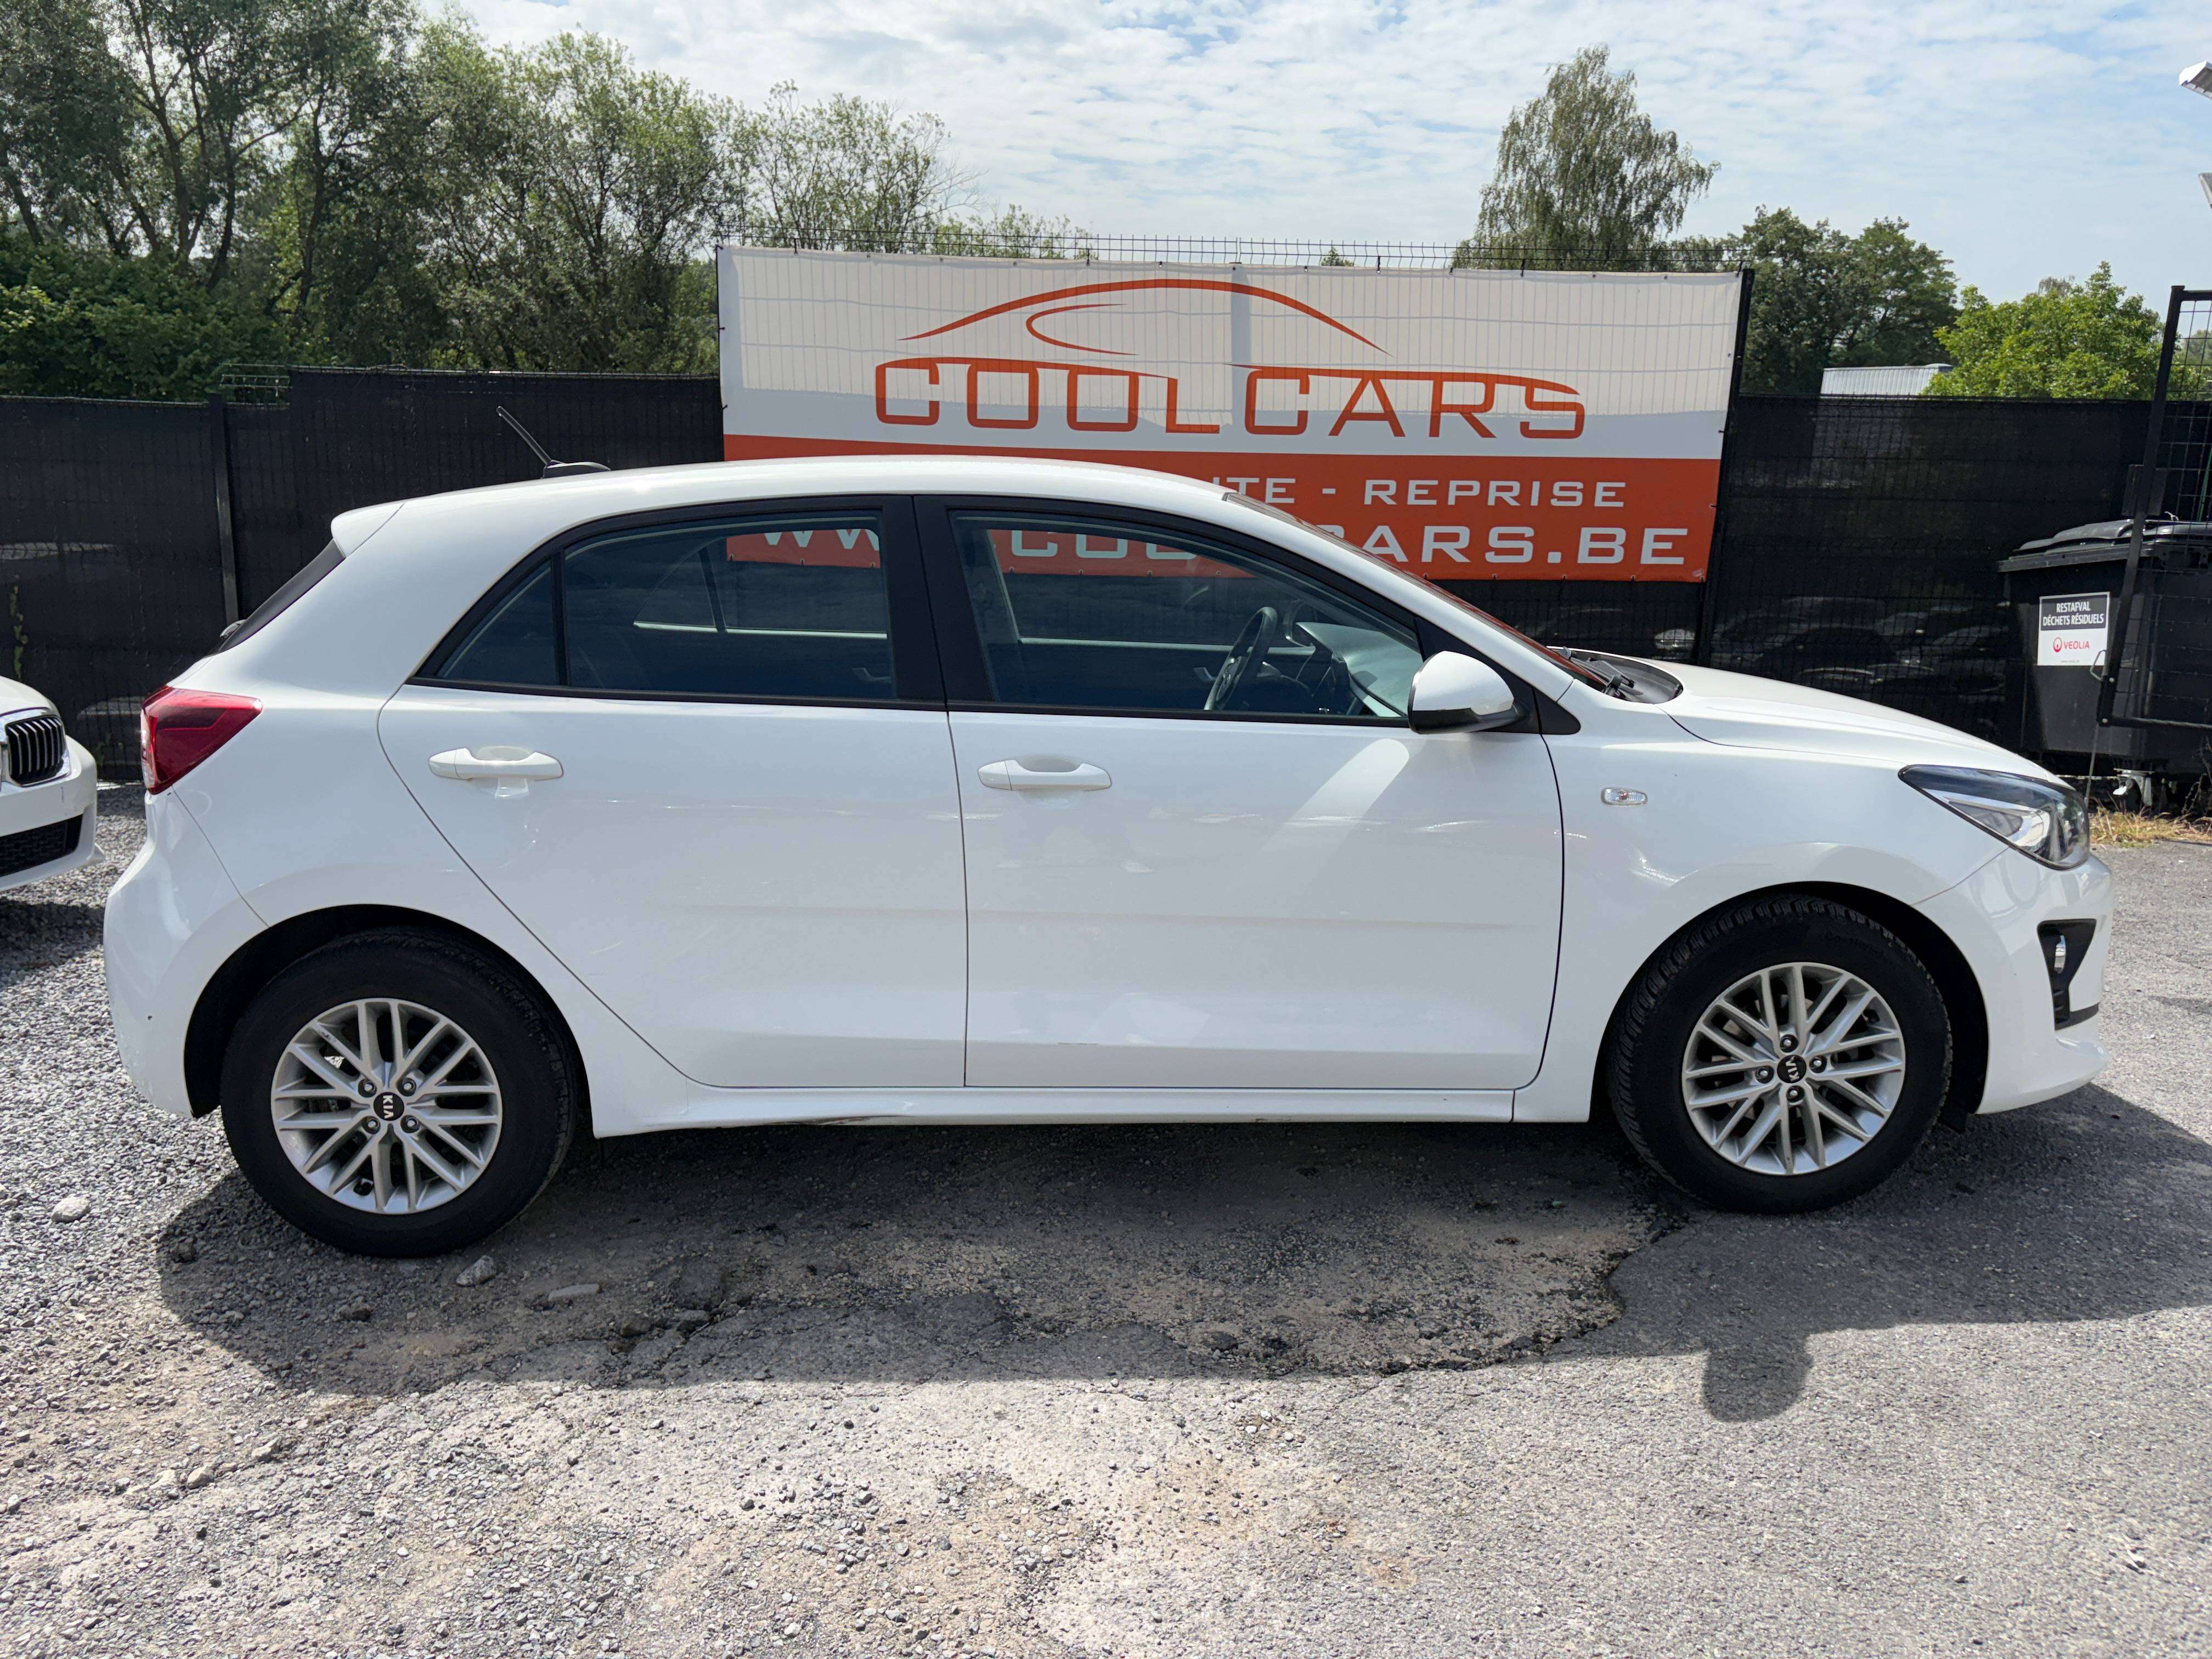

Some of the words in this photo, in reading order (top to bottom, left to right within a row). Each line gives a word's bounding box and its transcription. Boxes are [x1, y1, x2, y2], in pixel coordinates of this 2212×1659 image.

[876, 357, 1220, 434] COOL
[1244, 364, 1585, 439] CARS
[1364, 479, 1627, 508] REPRISE
[2042, 614, 2070, 626] DÉCHETS
[2071, 613, 2104, 625] RÉSIDUELS
[2056, 601, 2091, 613] RESTAFVAL
[2064, 641, 2090, 650] VEOLIA
[1785, 1056, 1799, 1081] KIA
[383, 1094, 394, 1119] KIA
